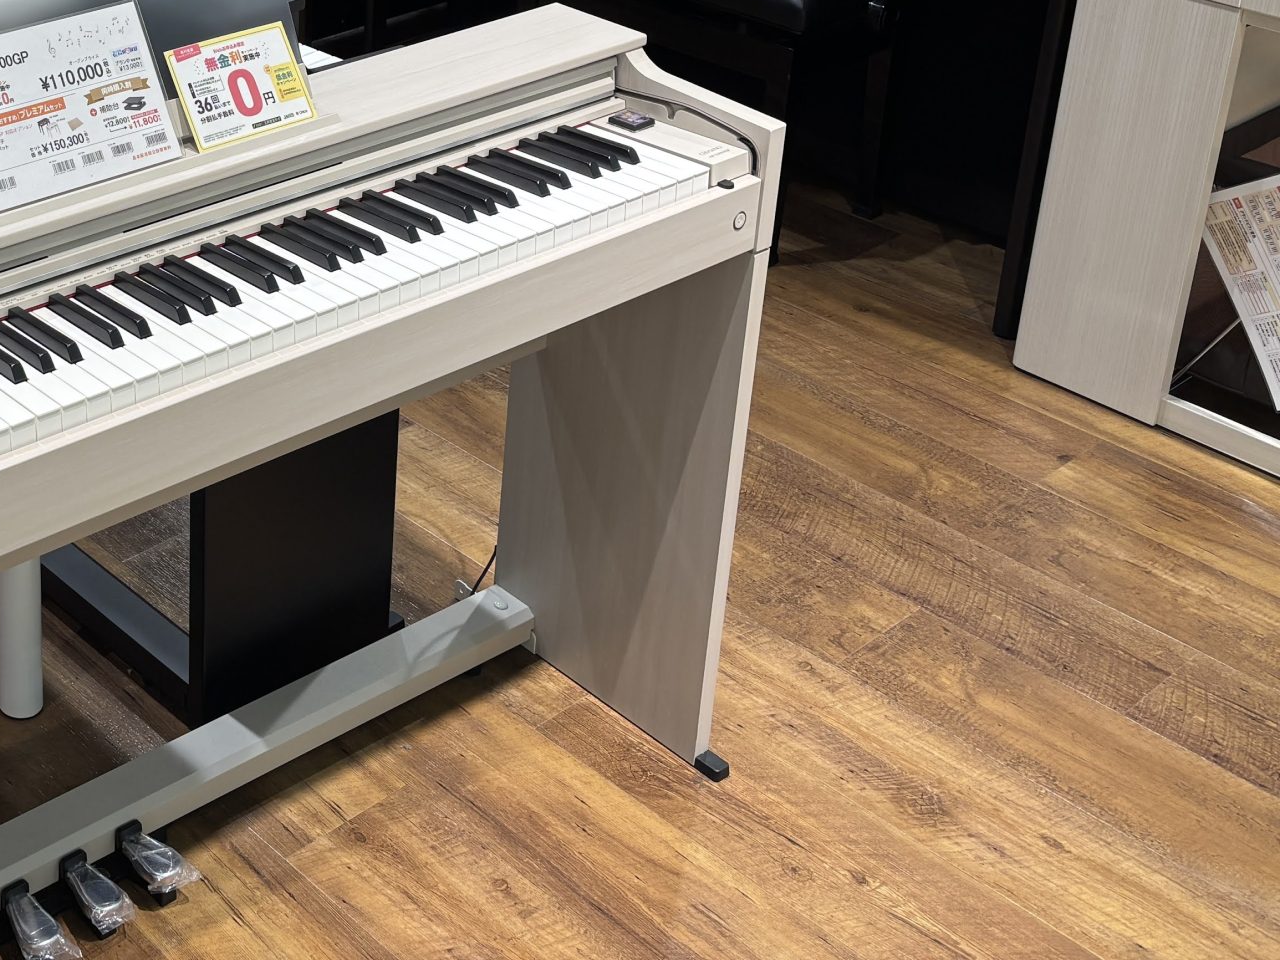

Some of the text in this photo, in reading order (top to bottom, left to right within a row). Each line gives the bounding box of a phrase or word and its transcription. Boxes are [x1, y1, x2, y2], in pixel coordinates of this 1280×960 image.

[204, 50, 242, 72] 無金利
[242, 53, 261, 62] 実施中
[39, 63, 103, 92] ¥110,000
[100, 102, 119, 114] 補助台
[42, 133, 85, 153] ¥150,300
